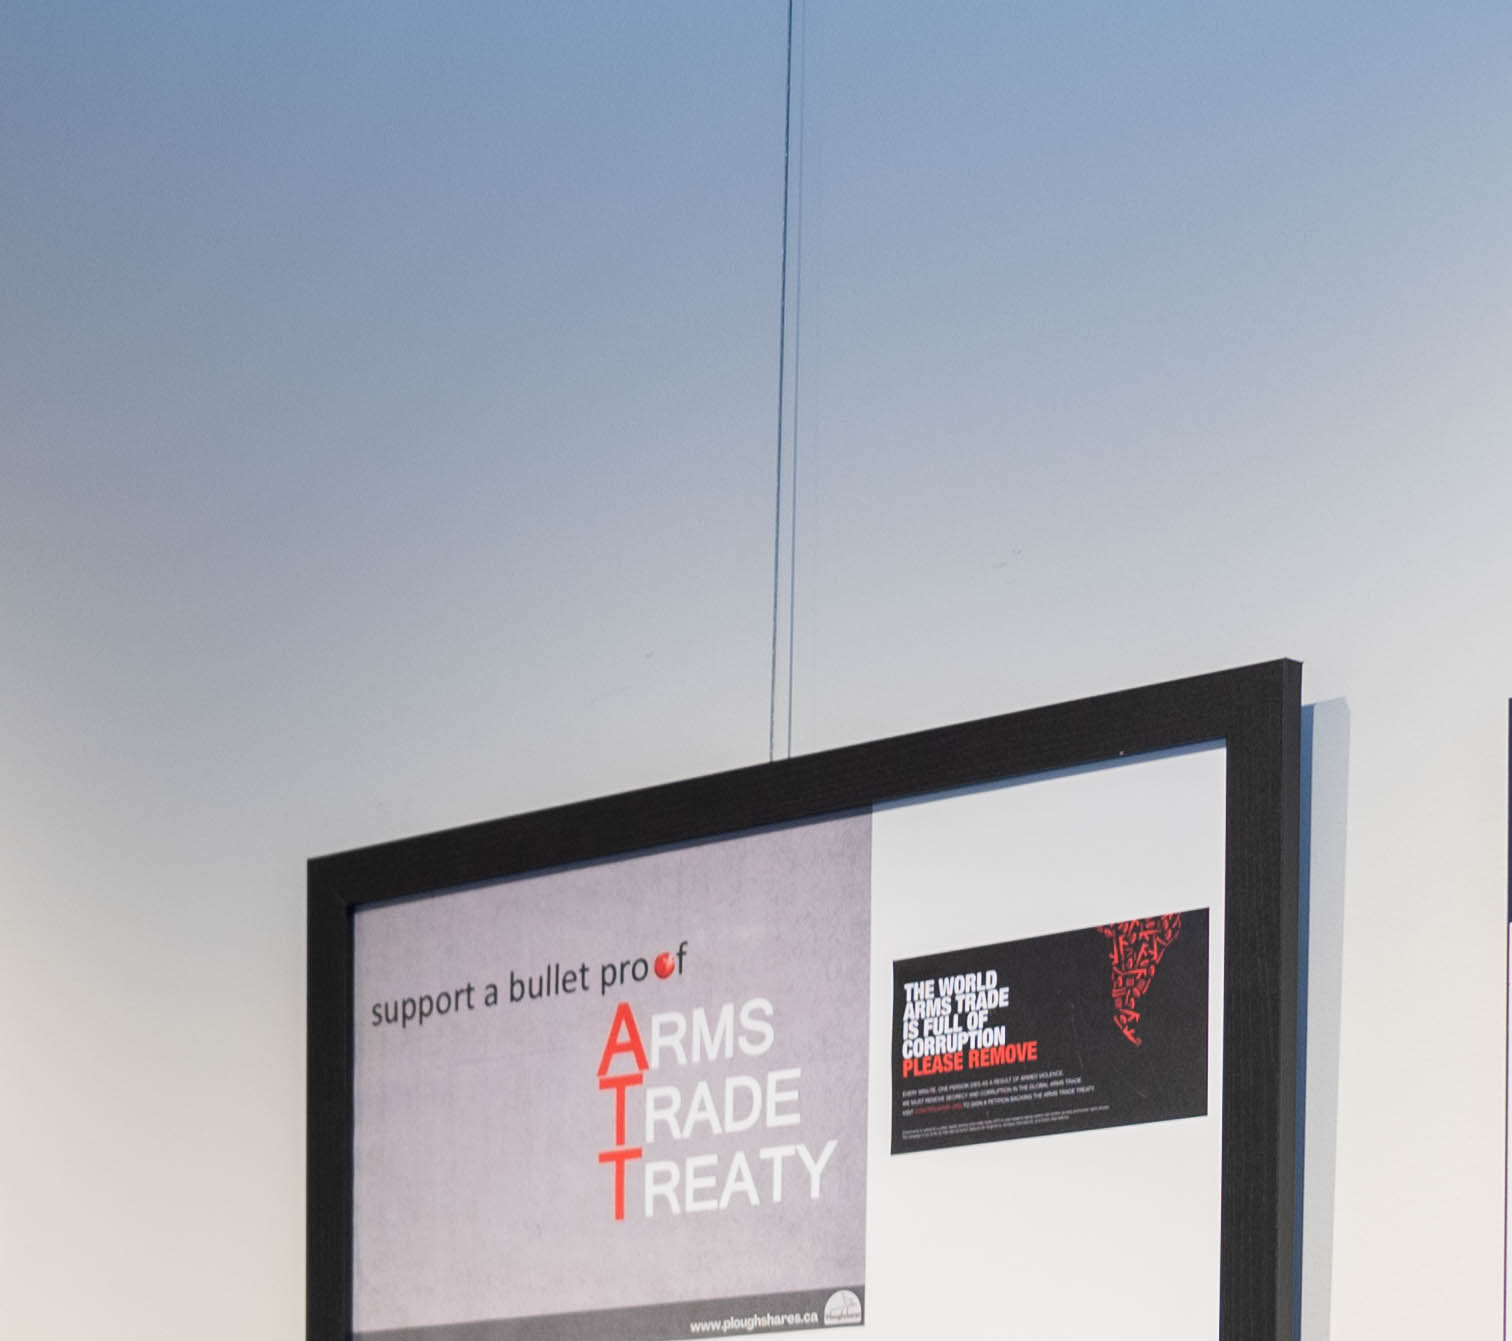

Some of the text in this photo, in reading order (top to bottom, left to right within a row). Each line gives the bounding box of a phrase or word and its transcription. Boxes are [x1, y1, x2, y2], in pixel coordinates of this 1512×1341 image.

[372, 983, 474, 1029] support
[485, 984, 497, 1006] a
[510, 963, 589, 1002] bullet
[904, 970, 997, 1001] THE WORLD
[903, 987, 1009, 1021] ARMS TRADE
[597, 997, 775, 1076] ARMS
[902, 1026, 1006, 1059] CORRUPTION
[903, 1010, 988, 1040] IS FULL OF
[903, 1041, 1038, 1078] PLEASE REMOVE
[597, 1069, 799, 1147] TRADE
[598, 1139, 838, 1221] TREATY
[690, 1312, 818, 1332] www.ploughshares.ca
